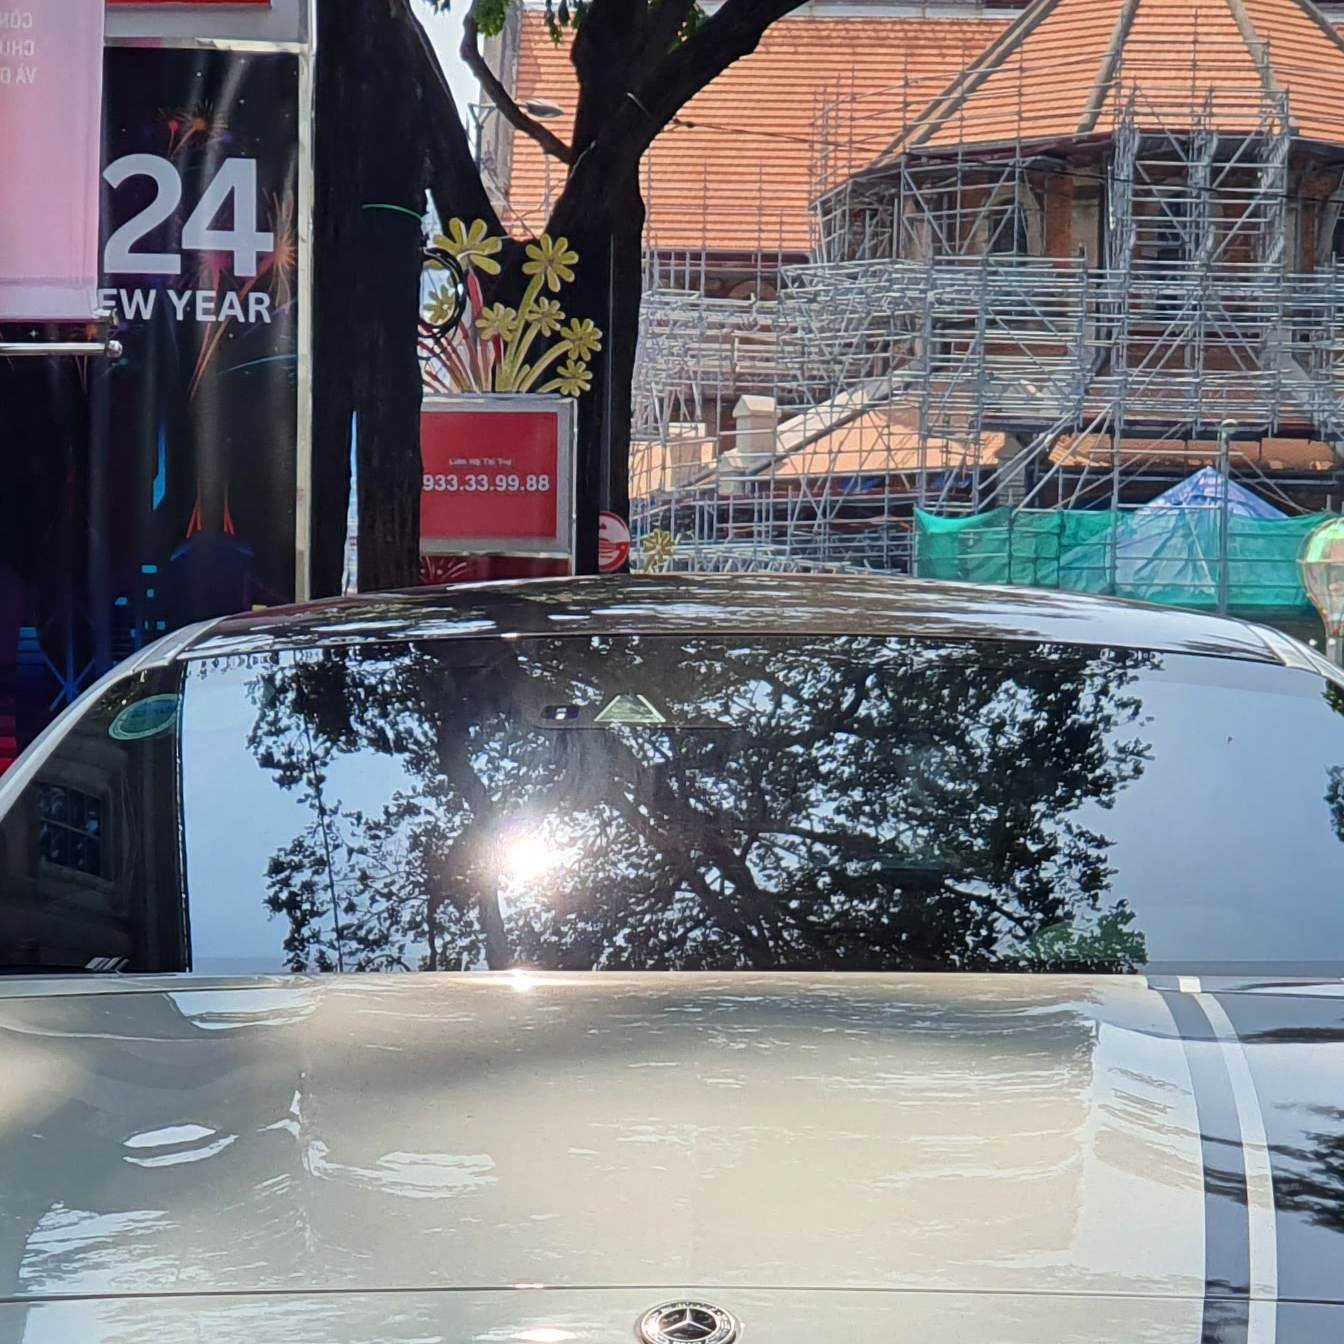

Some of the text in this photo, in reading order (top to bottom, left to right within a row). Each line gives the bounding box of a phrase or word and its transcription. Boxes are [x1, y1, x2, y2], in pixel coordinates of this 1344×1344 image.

[102, 153, 274, 277] 24
[98, 288, 272, 324] EW YEAR
[423, 474, 550, 492] 933.33.99.88
